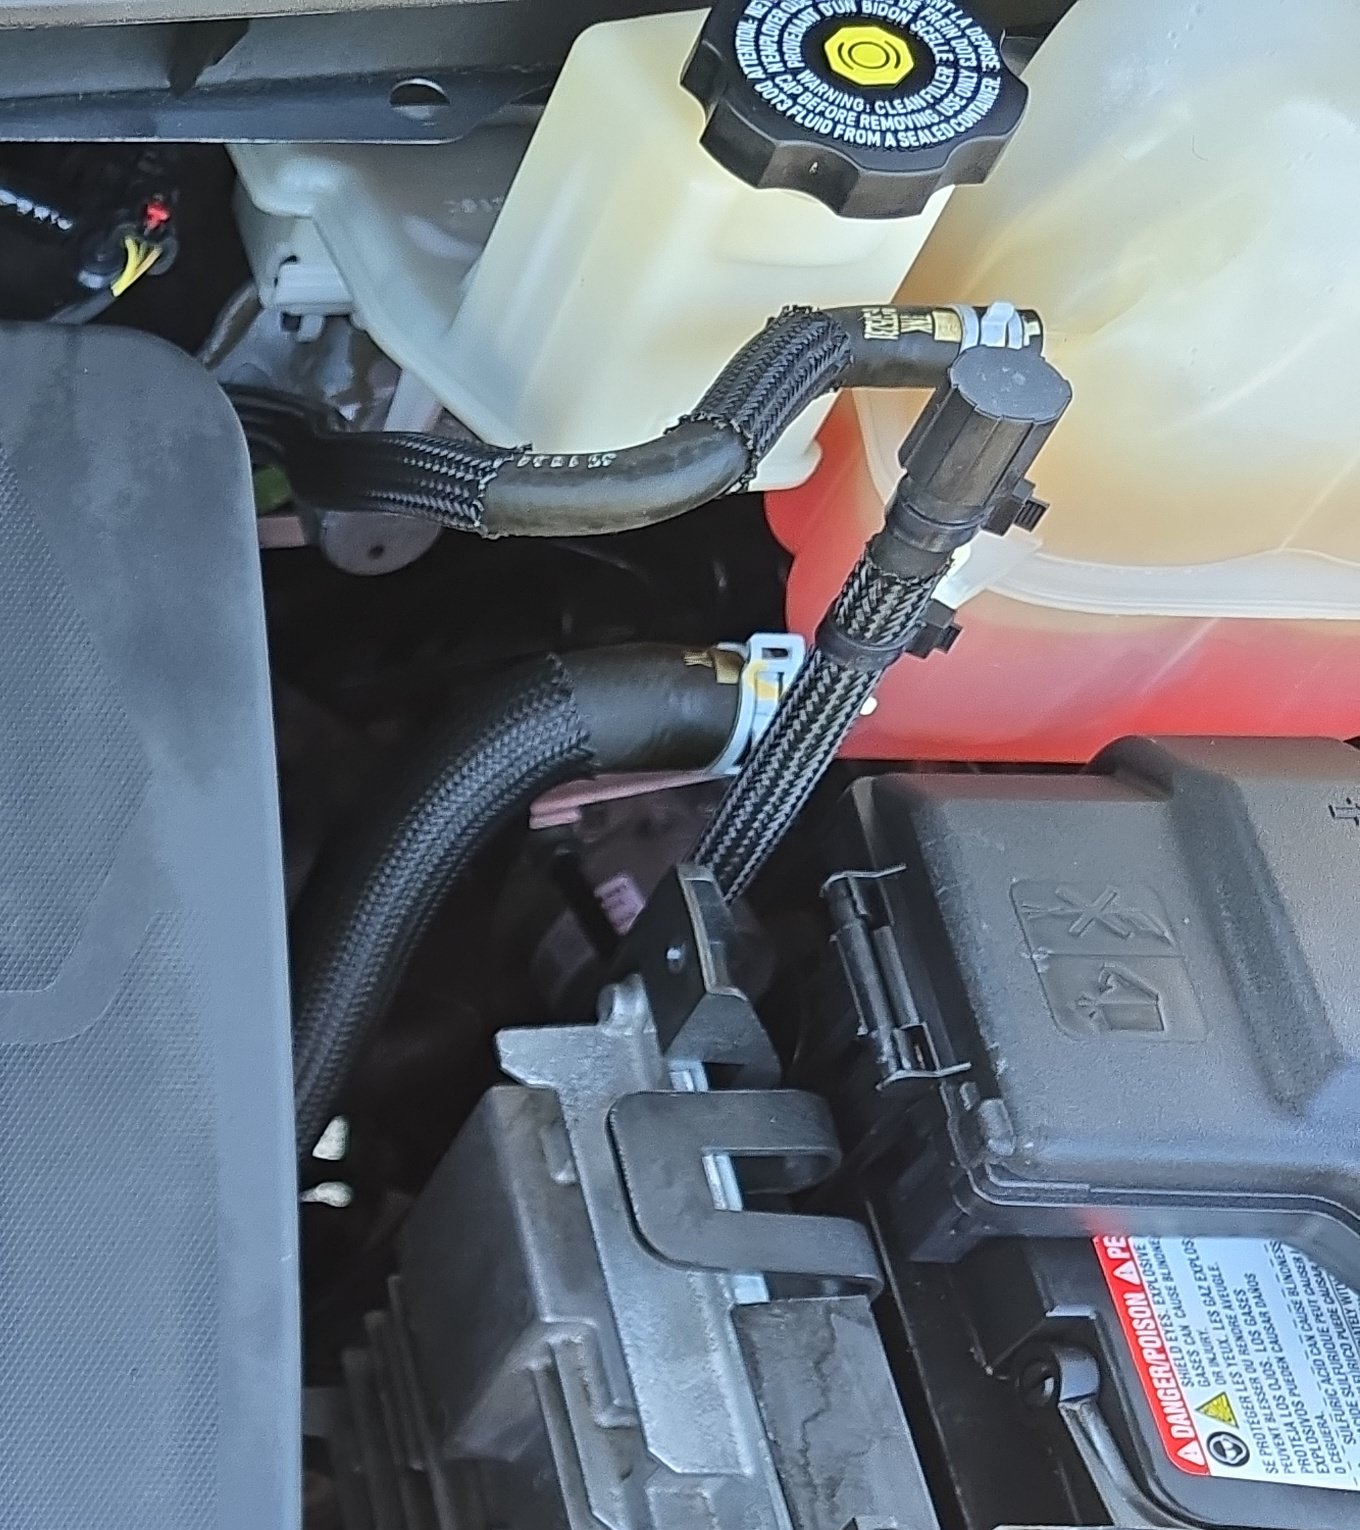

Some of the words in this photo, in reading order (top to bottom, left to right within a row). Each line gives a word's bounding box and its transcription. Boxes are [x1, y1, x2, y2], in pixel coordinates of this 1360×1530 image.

[782, 7, 821, 69] PROVENANT
[861, 0, 912, 25] BIDON
[919, 6, 961, 39] FREIN
[951, 38, 977, 67] DOT3
[949, 9, 973, 28] LA
[774, 74, 803, 95] CAP
[797, 91, 857, 126] BEFORE
[935, 93, 967, 117] USE
[954, 69, 978, 98] ONLY
[874, 94, 927, 115] CLEAN
[920, 66, 955, 103] FILLER
[754, 80, 793, 112] DOT3
[785, 105, 833, 135] FLUID
[833, 124, 880, 147] FROM
[884, 131, 897, 147] A
[897, 122, 955, 148] SEALED
[1134, 1242, 1166, 1305] EXPLOSIVE
[1292, 1256, 1315, 1296] CAUSER
[1165, 1285, 1186, 1318] CAUSE
[1198, 1285, 1217, 1306] GAZ
[1233, 1289, 1257, 1326] GASES
[1307, 1298, 1326, 1324] PEUT
[1207, 1310, 1225, 1331] LES
[1225, 1314, 1250, 1355] RENDRE
[1259, 1311, 1283, 1353] CAUSAR
[1290, 1299, 1312, 1332] CAUSE
[1326, 1307, 1349, 1340] PUEDE
[1179, 1325, 1196, 1346] CAN
[1248, 1330, 1267, 1352] LOS
[1304, 1334, 1321, 1356] CAN
[1123, 1292, 1195, 1439] DANGER/POISON
[1169, 1346, 1195, 1387] SHIELD
[1187, 1350, 1210, 1387] GASES
[1212, 1370, 1227, 1385] OR
[1242, 1359, 1256, 1373] OU
[1275, 1356, 1301, 1397] PUEDEN
[1313, 1358, 1334, 1386] ACID
[1316, 1326, 1355, 1398] SULFURIQUE
[1229, 1371, 1247, 1392] LES
[1249, 1377, 1276, 1422] BLESSER
[1273, 1395, 1292, 1418] LOS
[1324, 1388, 1357, 1444] SULFURIC
[1268, 1426, 1296, 1474] PEUVENT
[1283, 1421, 1314, 1474] PROTEJA
[1291, 1400, 1330, 1474] EXPLOSIVOS
[1262, 1460, 1279, 1474] SE
